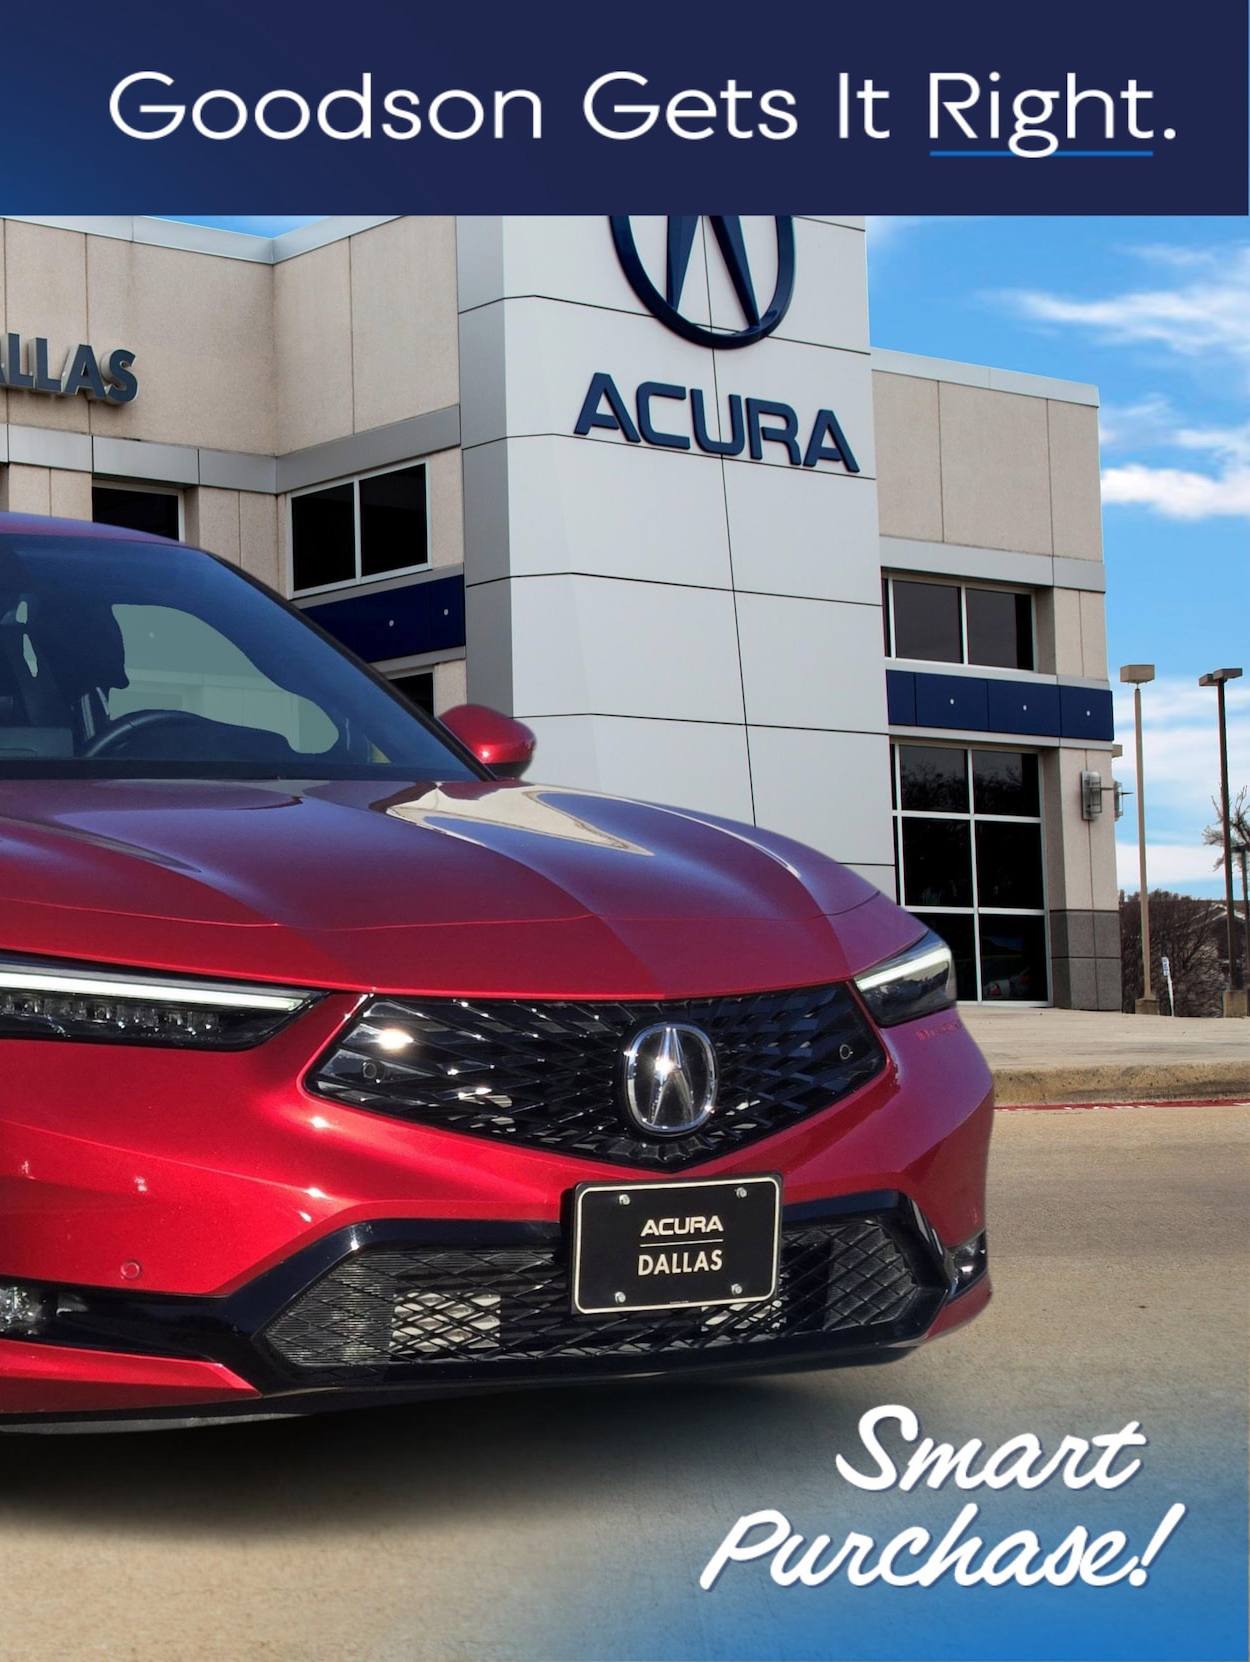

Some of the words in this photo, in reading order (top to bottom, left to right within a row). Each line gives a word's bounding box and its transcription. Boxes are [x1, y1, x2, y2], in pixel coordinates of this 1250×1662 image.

[573, 372, 860, 473] ACURA
[640, 1215, 724, 1237] ACURA
[637, 1249, 723, 1276] DALLAS
